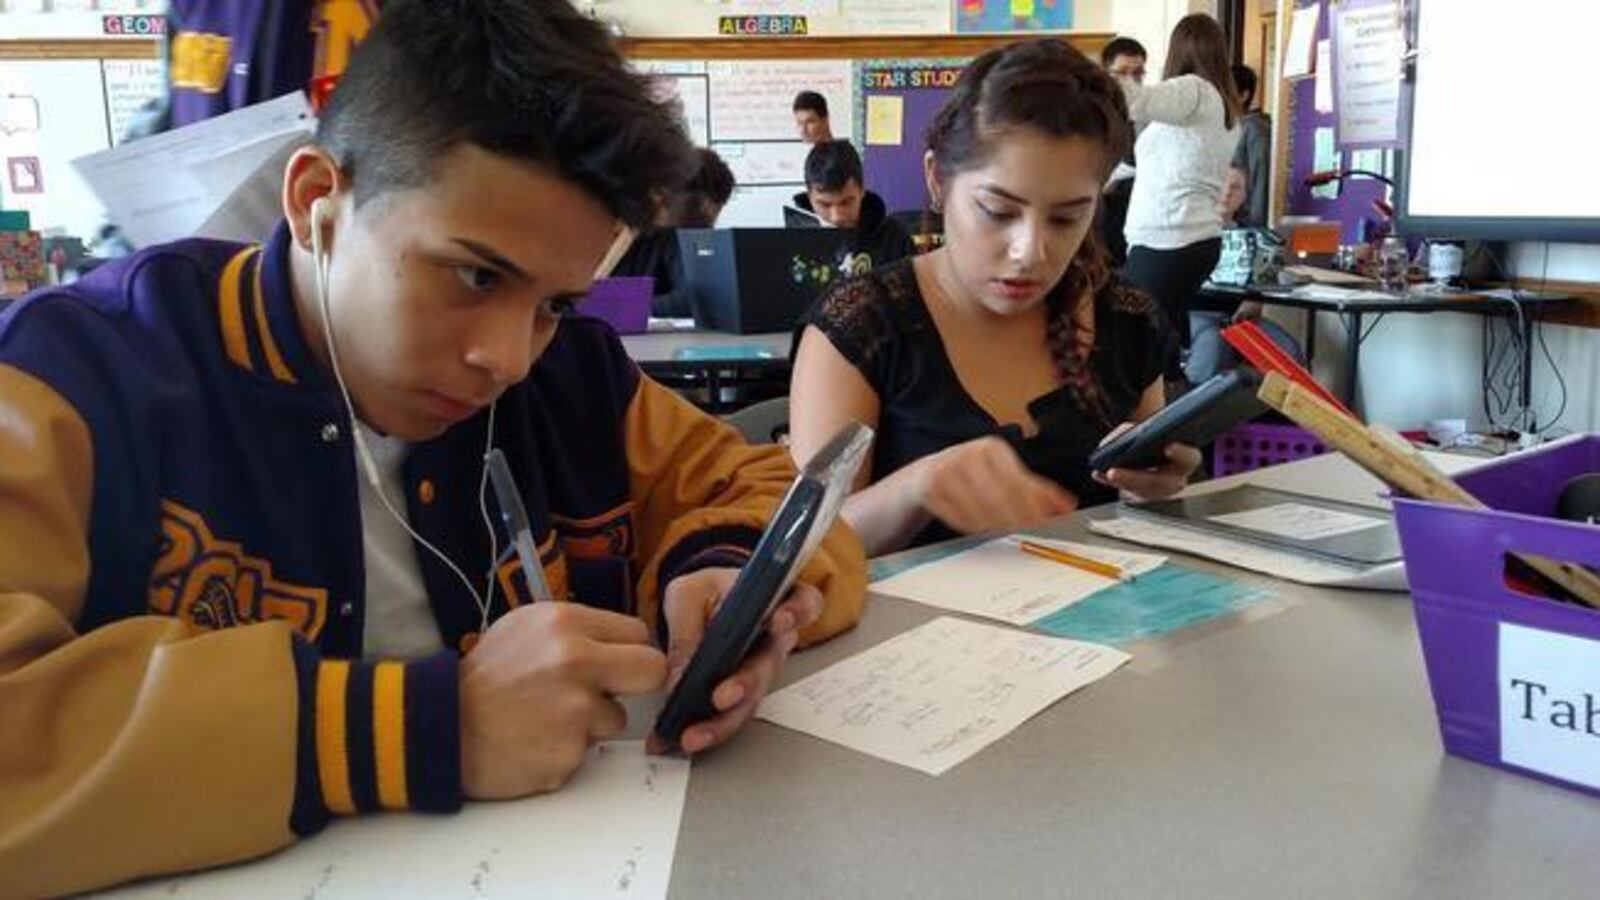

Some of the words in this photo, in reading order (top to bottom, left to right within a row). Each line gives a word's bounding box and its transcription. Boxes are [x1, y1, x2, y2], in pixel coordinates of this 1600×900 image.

[720, 16, 807, 34] ALGEBRA
[864, 70, 906, 88] STAR
[911, 69, 961, 87] STUD
